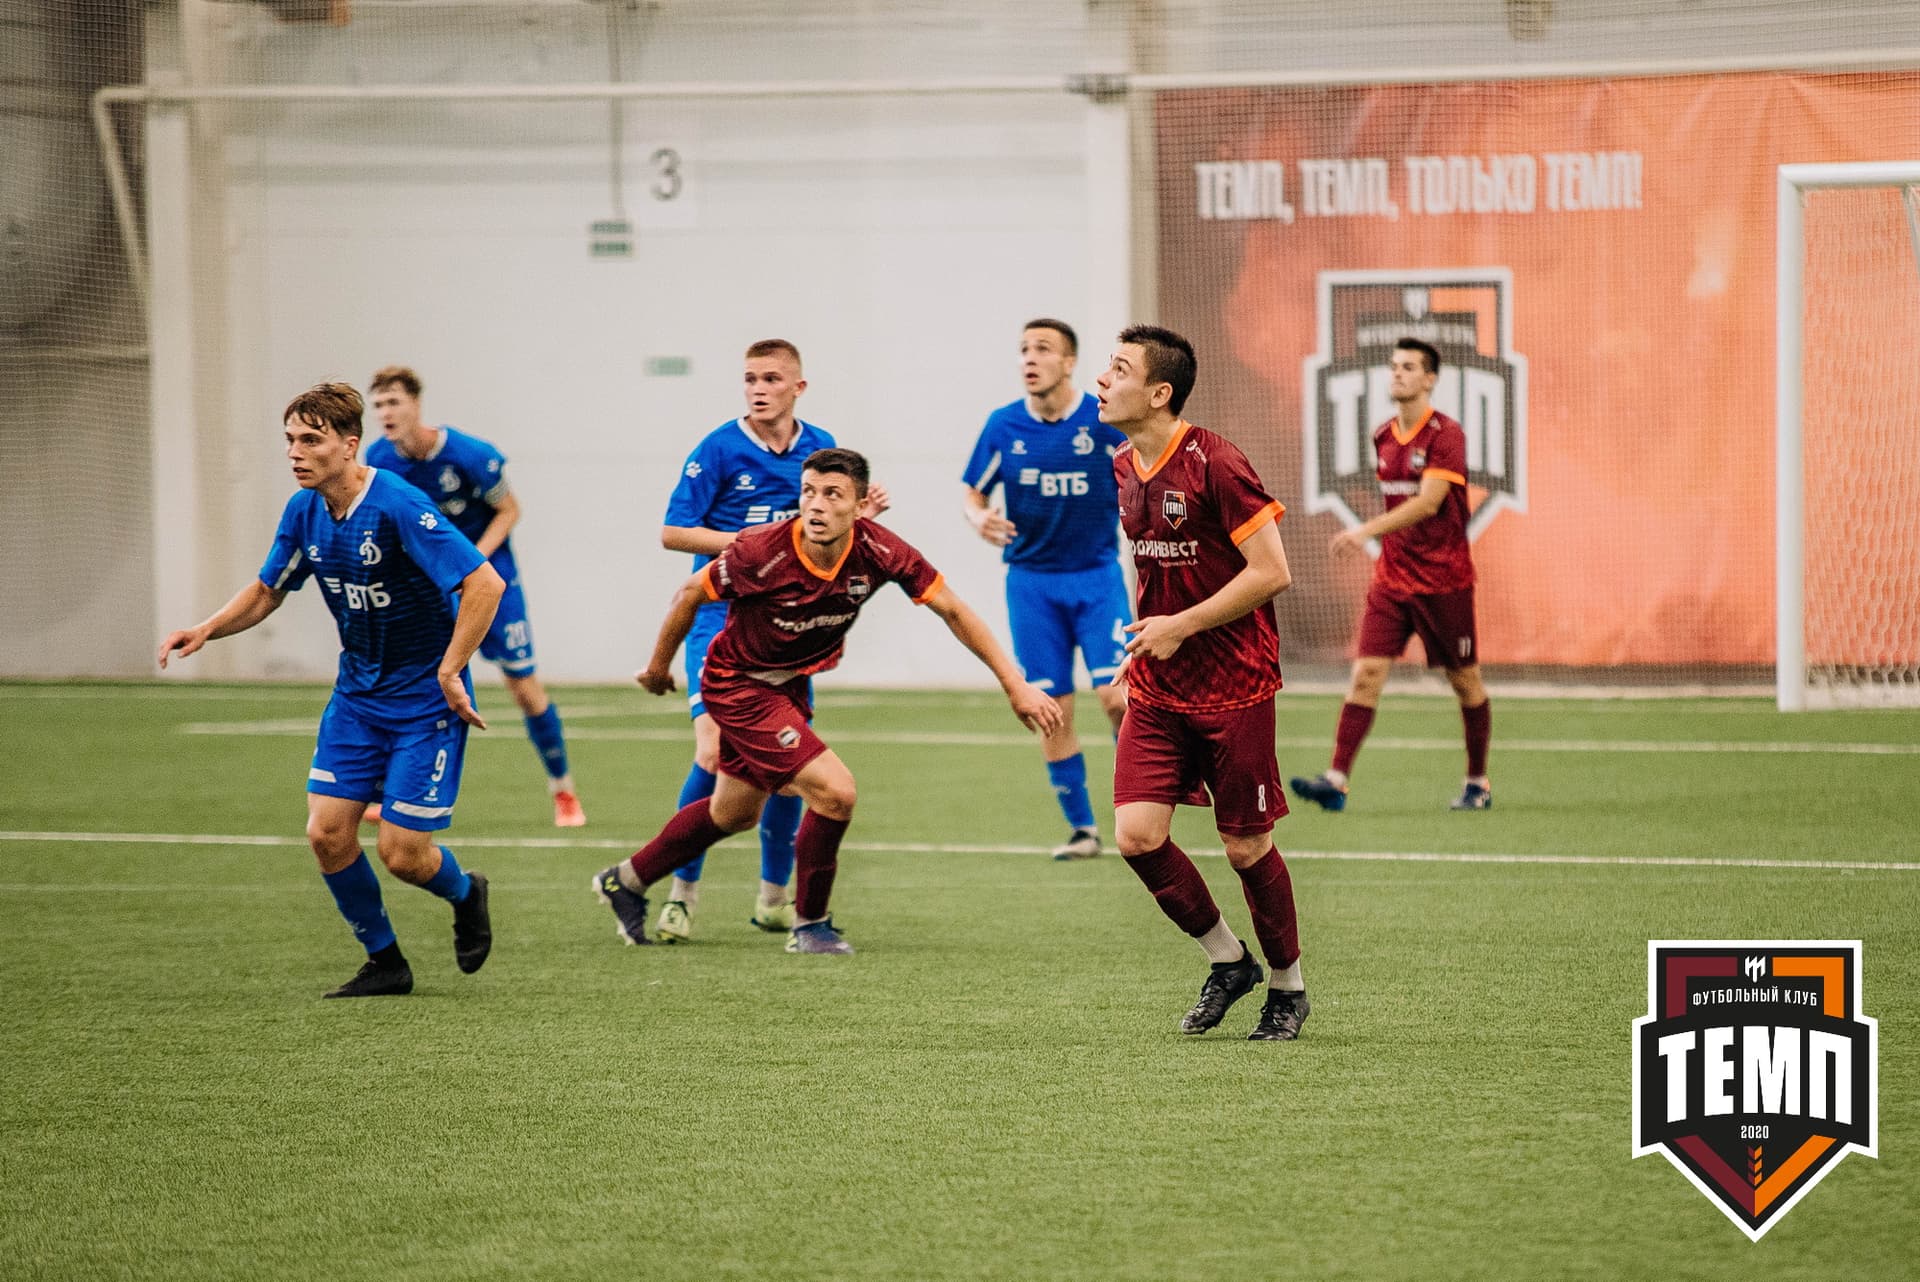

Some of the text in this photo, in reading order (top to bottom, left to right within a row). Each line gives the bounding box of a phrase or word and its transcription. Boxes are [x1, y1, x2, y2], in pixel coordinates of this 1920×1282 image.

[650, 147, 682, 201] 3
[1195, 151, 1643, 223] ТЕМП, ТЕМП, ТОЛЬКО ТЕМП!
[1040, 471, 1090, 497] ВТБ
[344, 582, 392, 612] ВТБ
[505, 620, 529, 650] 20
[1112, 618, 1127, 647] 4
[1459, 636, 1472, 658] 11
[431, 749, 447, 782] 9
[1257, 784, 1267, 812] 8
